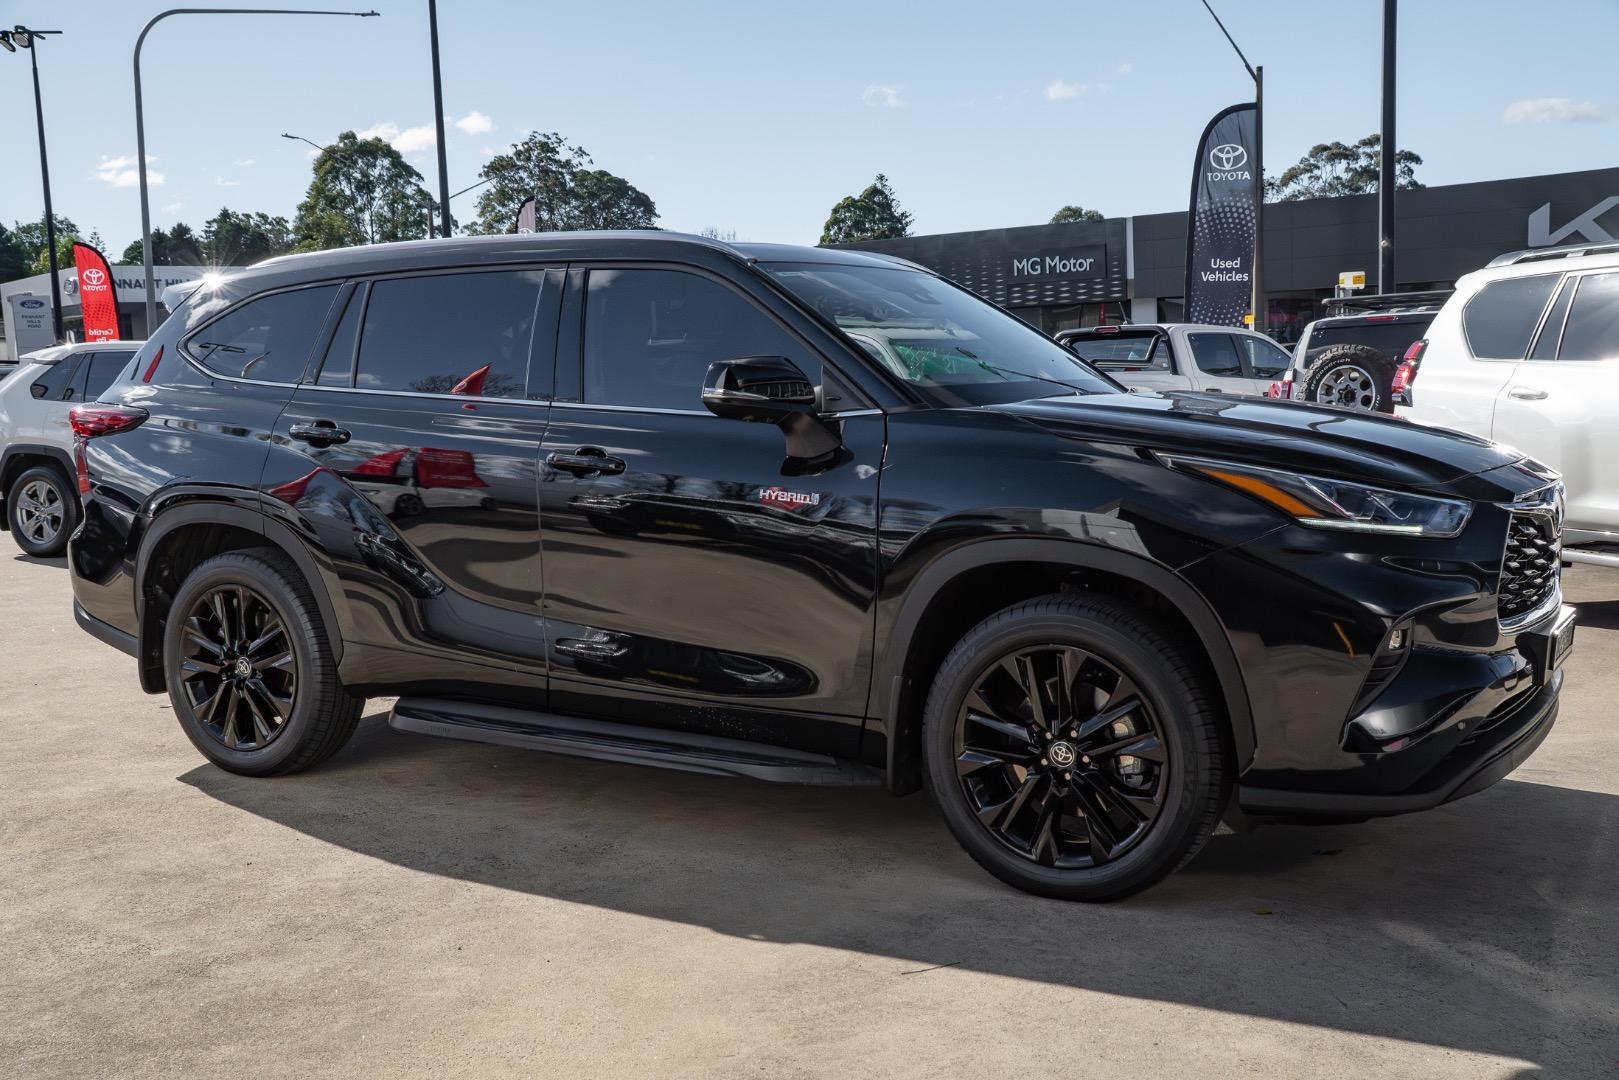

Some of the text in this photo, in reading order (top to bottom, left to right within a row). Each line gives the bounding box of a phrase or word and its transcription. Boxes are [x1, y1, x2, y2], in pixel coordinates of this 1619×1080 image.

[1207, 171, 1250, 181] TOYOTA
[1013, 255, 1094, 276] MG Motor
[1211, 257, 1240, 268] Used
[1201, 271, 1250, 281] Vehicles
[759, 488, 811, 503] HYBRID
